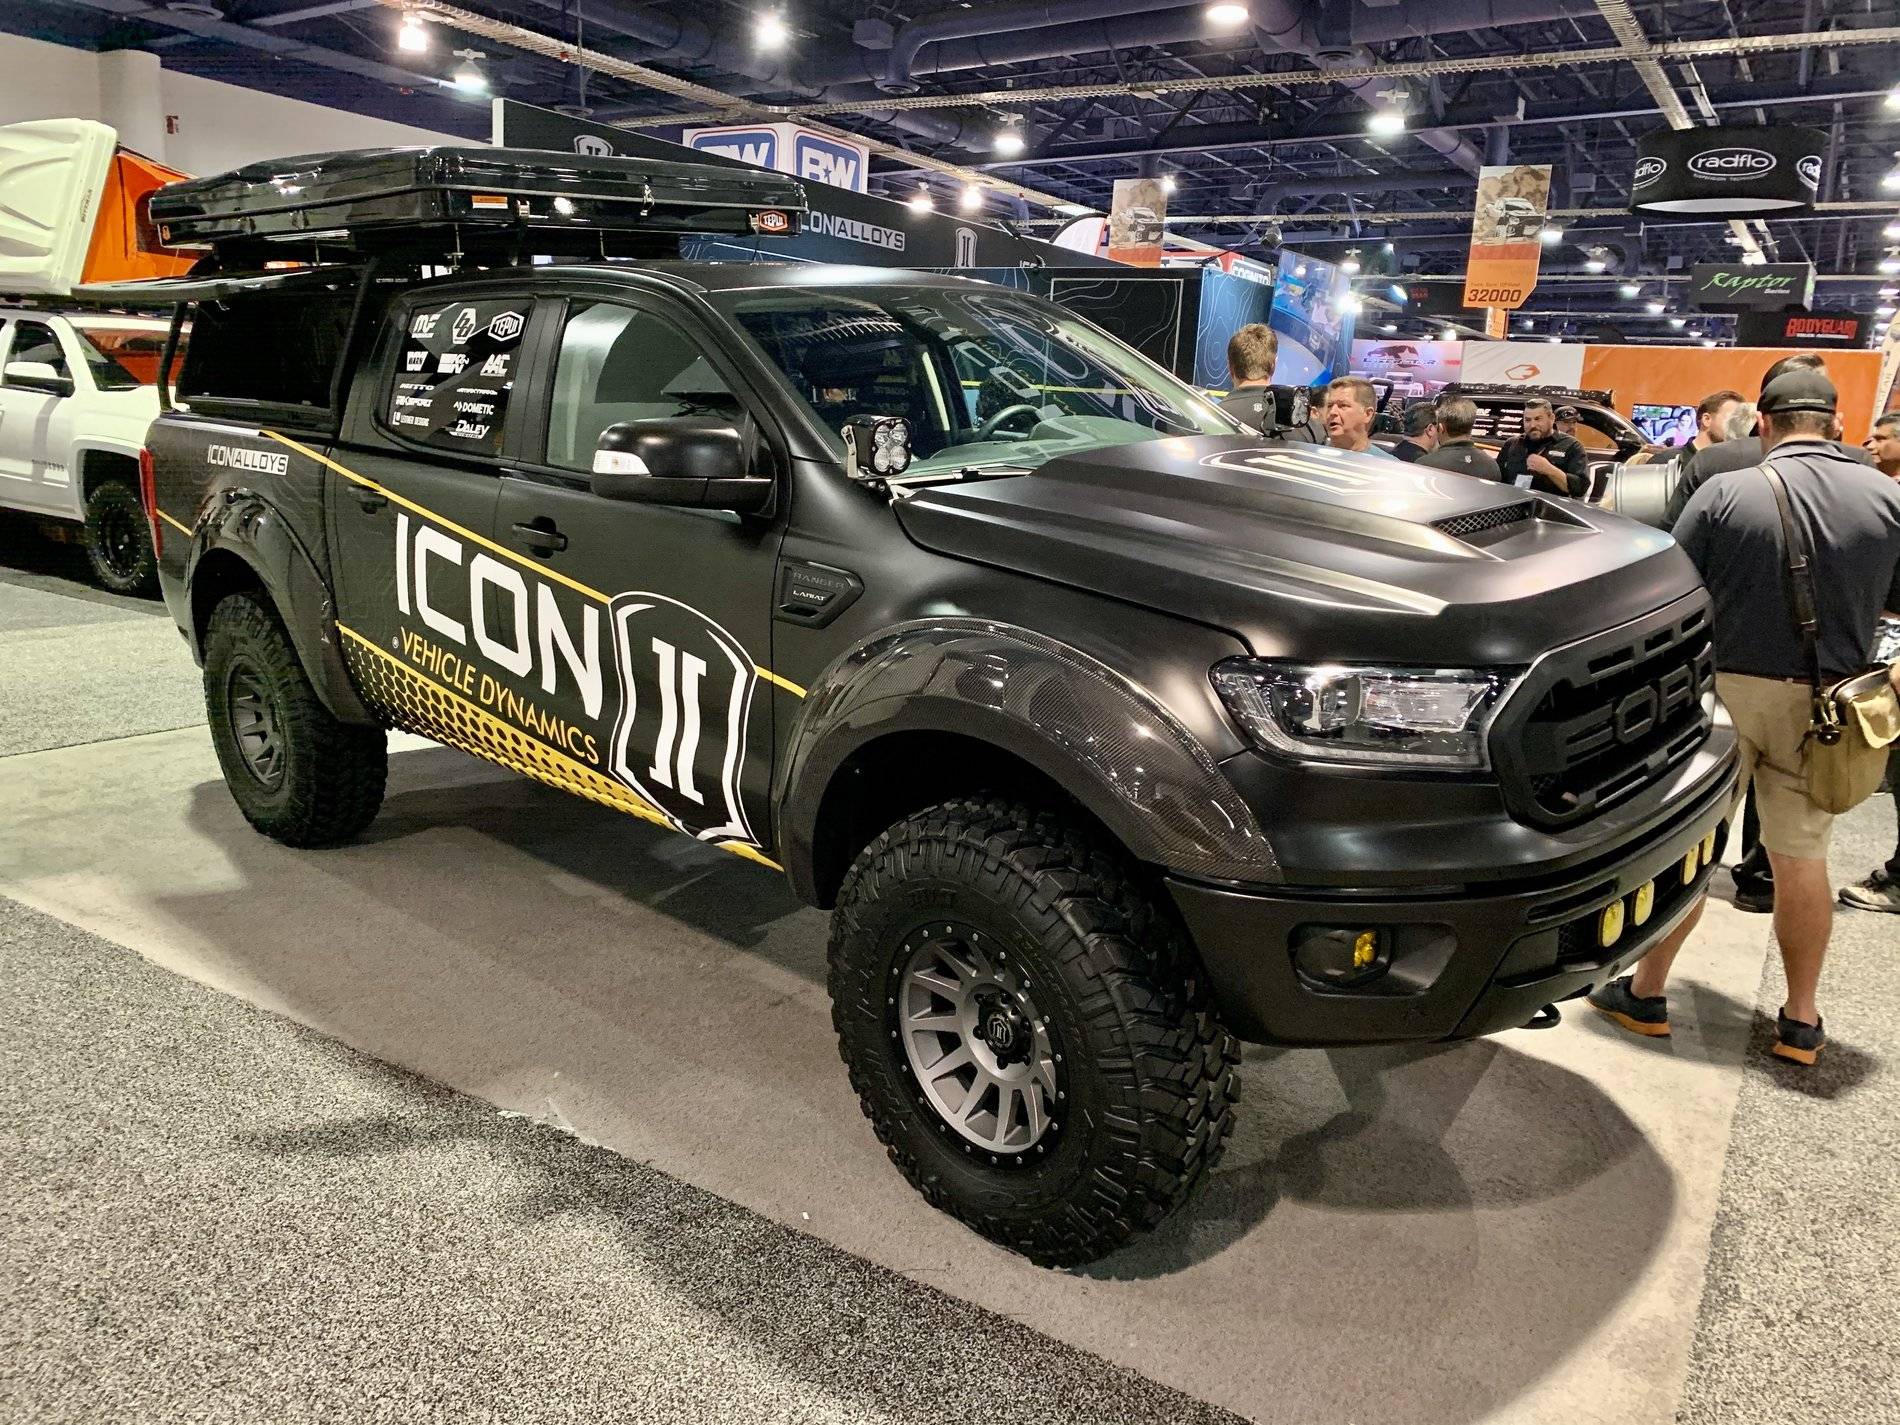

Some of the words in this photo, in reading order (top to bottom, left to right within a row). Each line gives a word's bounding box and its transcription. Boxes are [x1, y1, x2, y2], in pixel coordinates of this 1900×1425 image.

[1697, 154, 1769, 168] radflo
[1634, 163, 1661, 178] adflo
[1700, 272, 1797, 298] Raptor
[1468, 289, 1522, 302] 32000
[494, 316, 517, 336] TEPUI
[462, 402, 495, 415] DOMETIC
[793, 572, 845, 588] RANGER
[396, 512, 602, 721] ICON
[401, 626, 476, 696] VEHICLE
[480, 674, 599, 764] DYNAMICS
